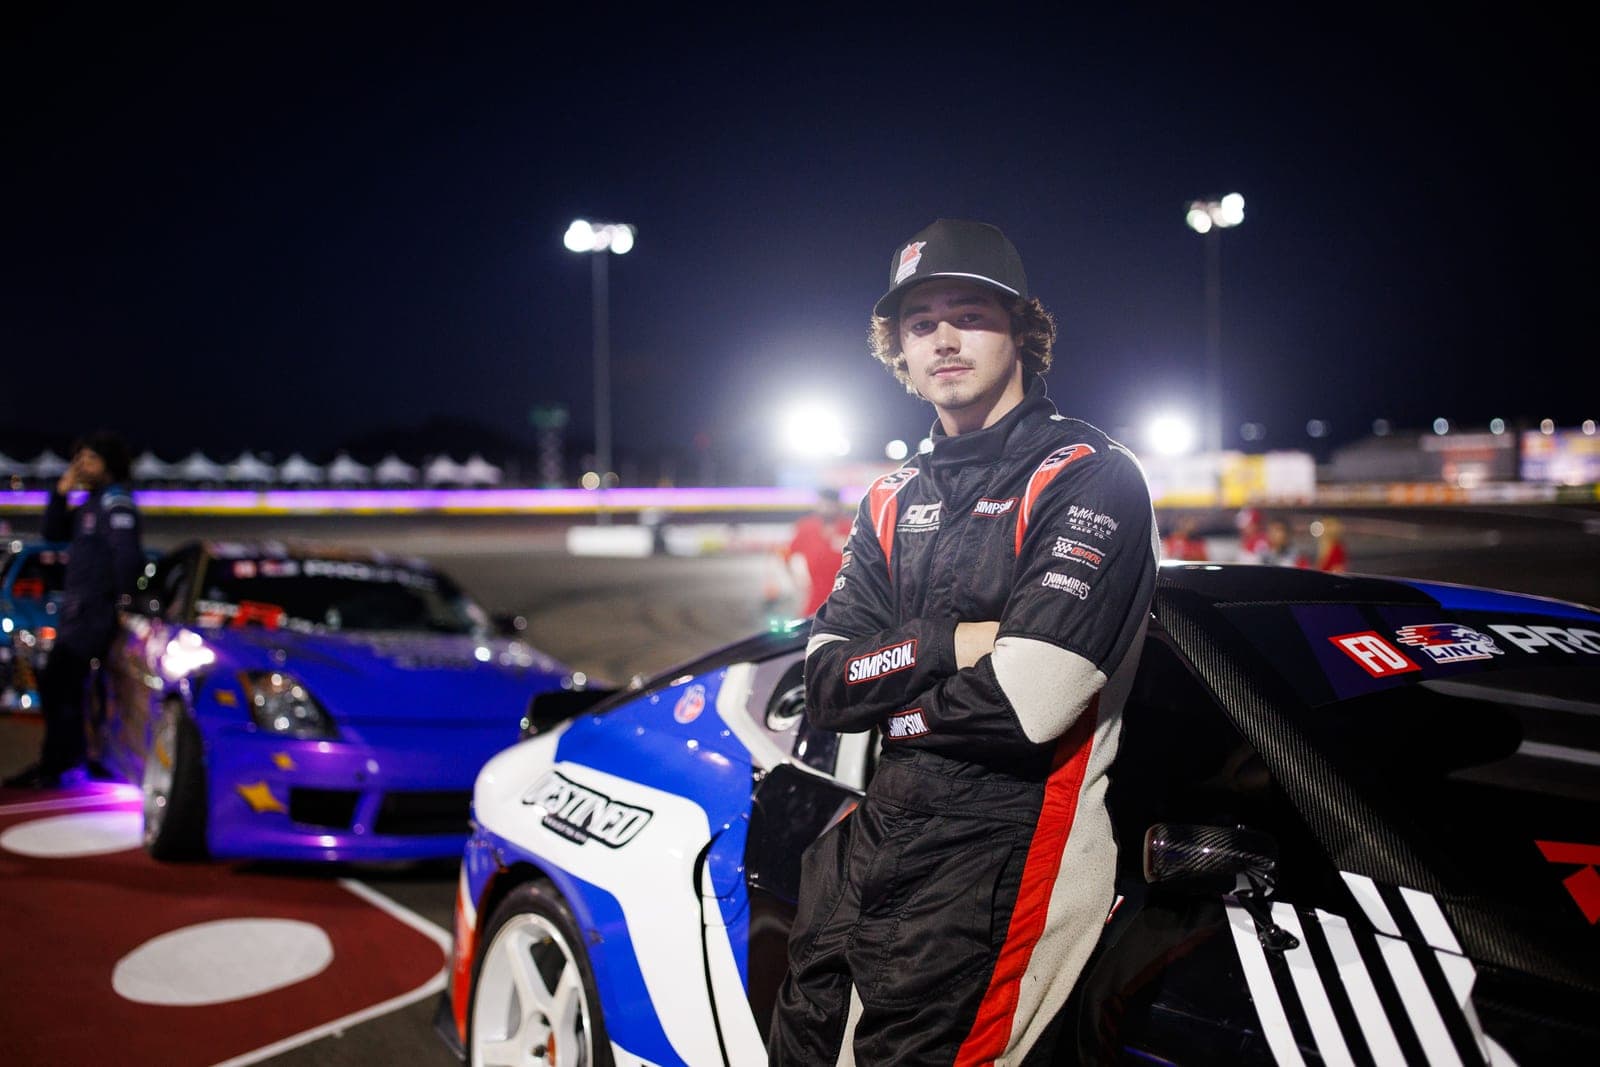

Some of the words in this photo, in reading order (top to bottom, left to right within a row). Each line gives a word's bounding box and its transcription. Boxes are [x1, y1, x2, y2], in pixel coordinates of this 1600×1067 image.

[974, 499, 1014, 514] SIMPSON
[1067, 505, 1094, 521] BLACK
[1093, 513, 1120, 531] WIDOW
[1339, 635, 1408, 673] FD
[1426, 644, 1487, 660] LINK
[888, 712, 927, 737] SIMPSON
